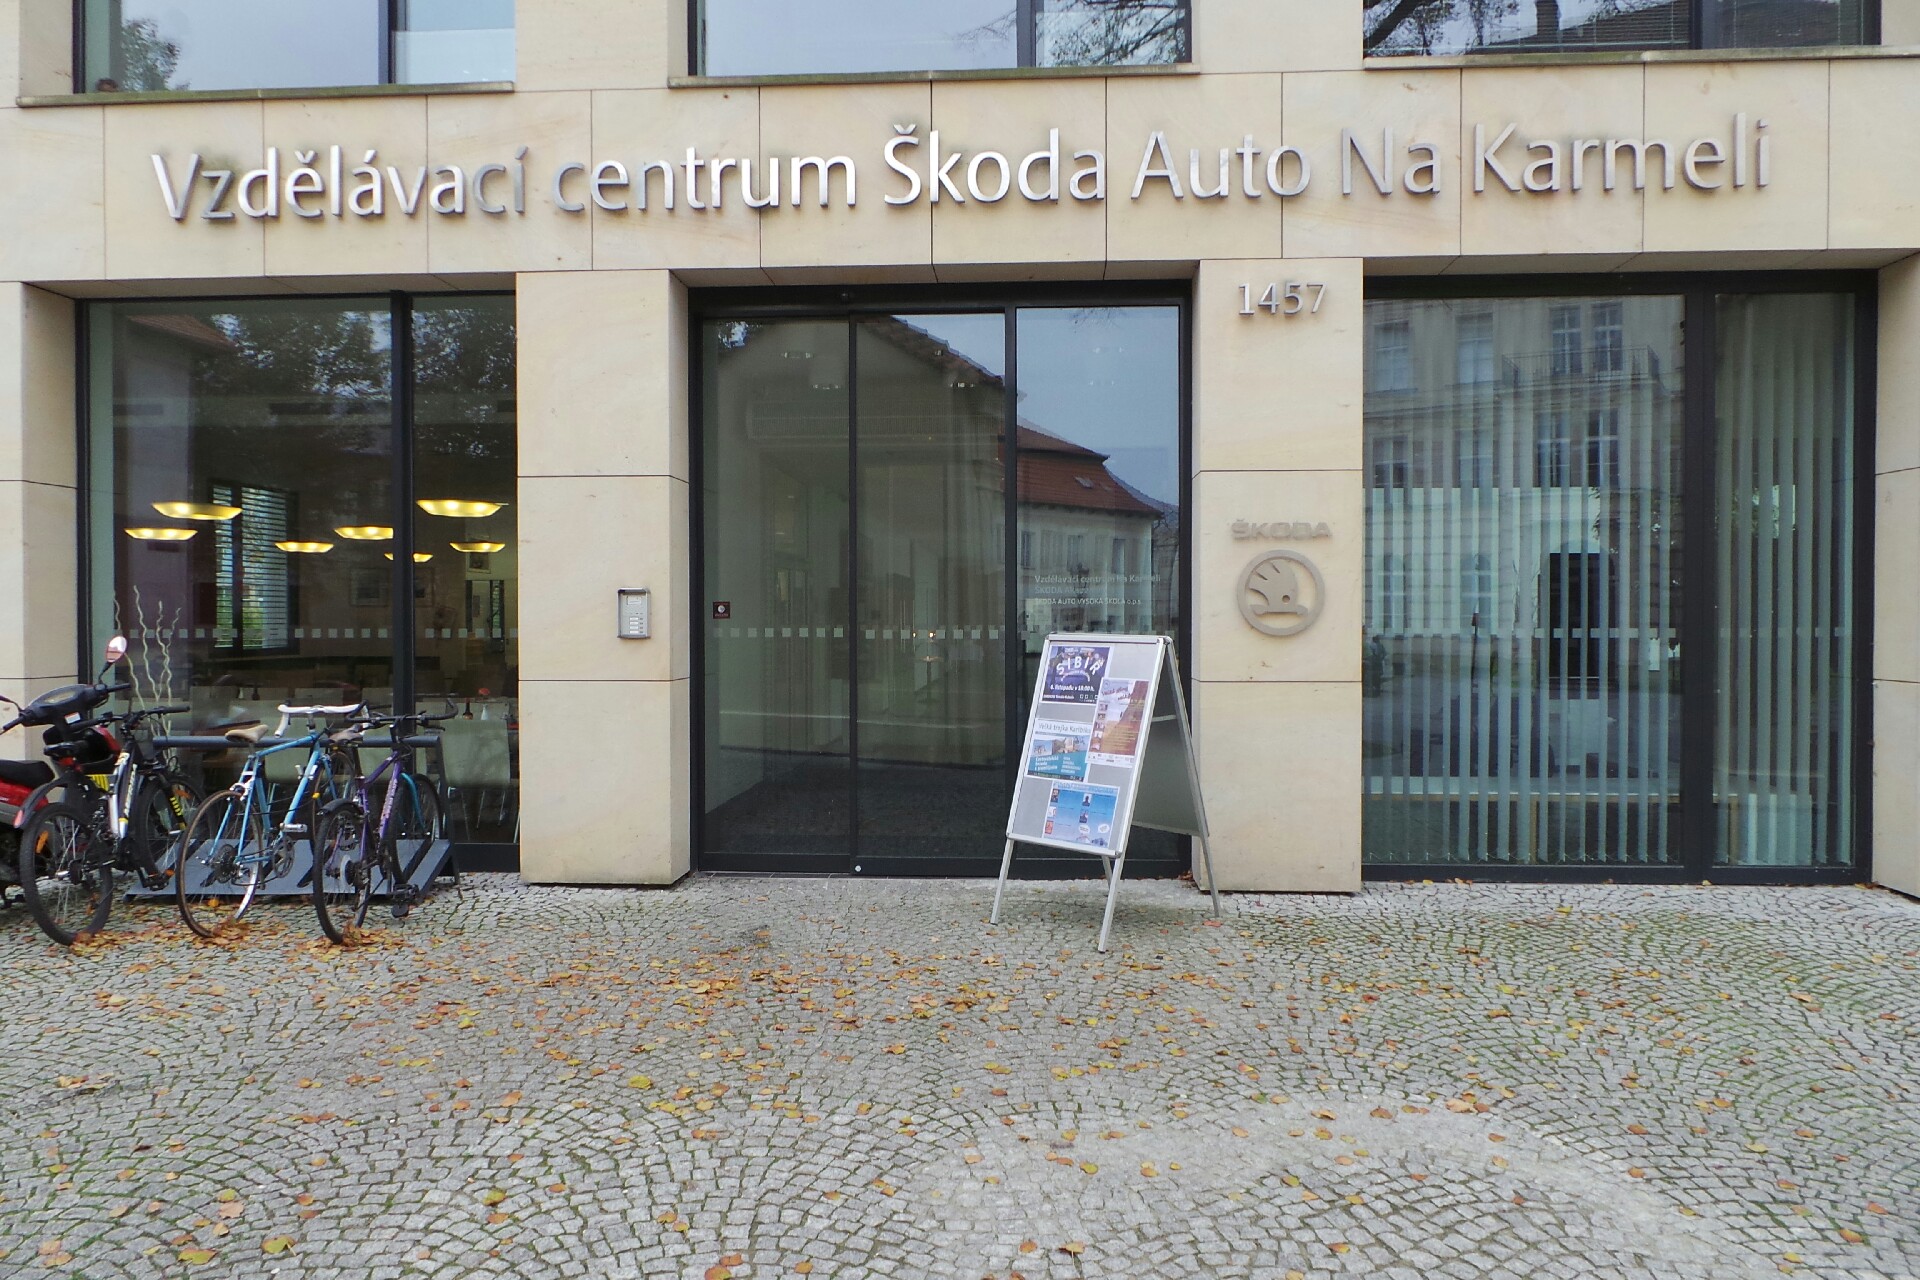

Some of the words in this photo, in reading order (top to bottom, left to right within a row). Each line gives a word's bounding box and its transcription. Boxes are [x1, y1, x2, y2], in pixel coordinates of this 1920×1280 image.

[151, 144, 528, 223] Vzdělávací
[549, 146, 857, 212] centrum
[883, 123, 1106, 207] Škoda
[1130, 130, 1313, 200] Auto
[1341, 127, 1442, 197] Na
[1472, 112, 1771, 194] Karmeli
[1238, 282, 1328, 316] 1457
[1231, 518, 1333, 541] ŠKODA
[1129, 574, 1161, 582] Kaeli
